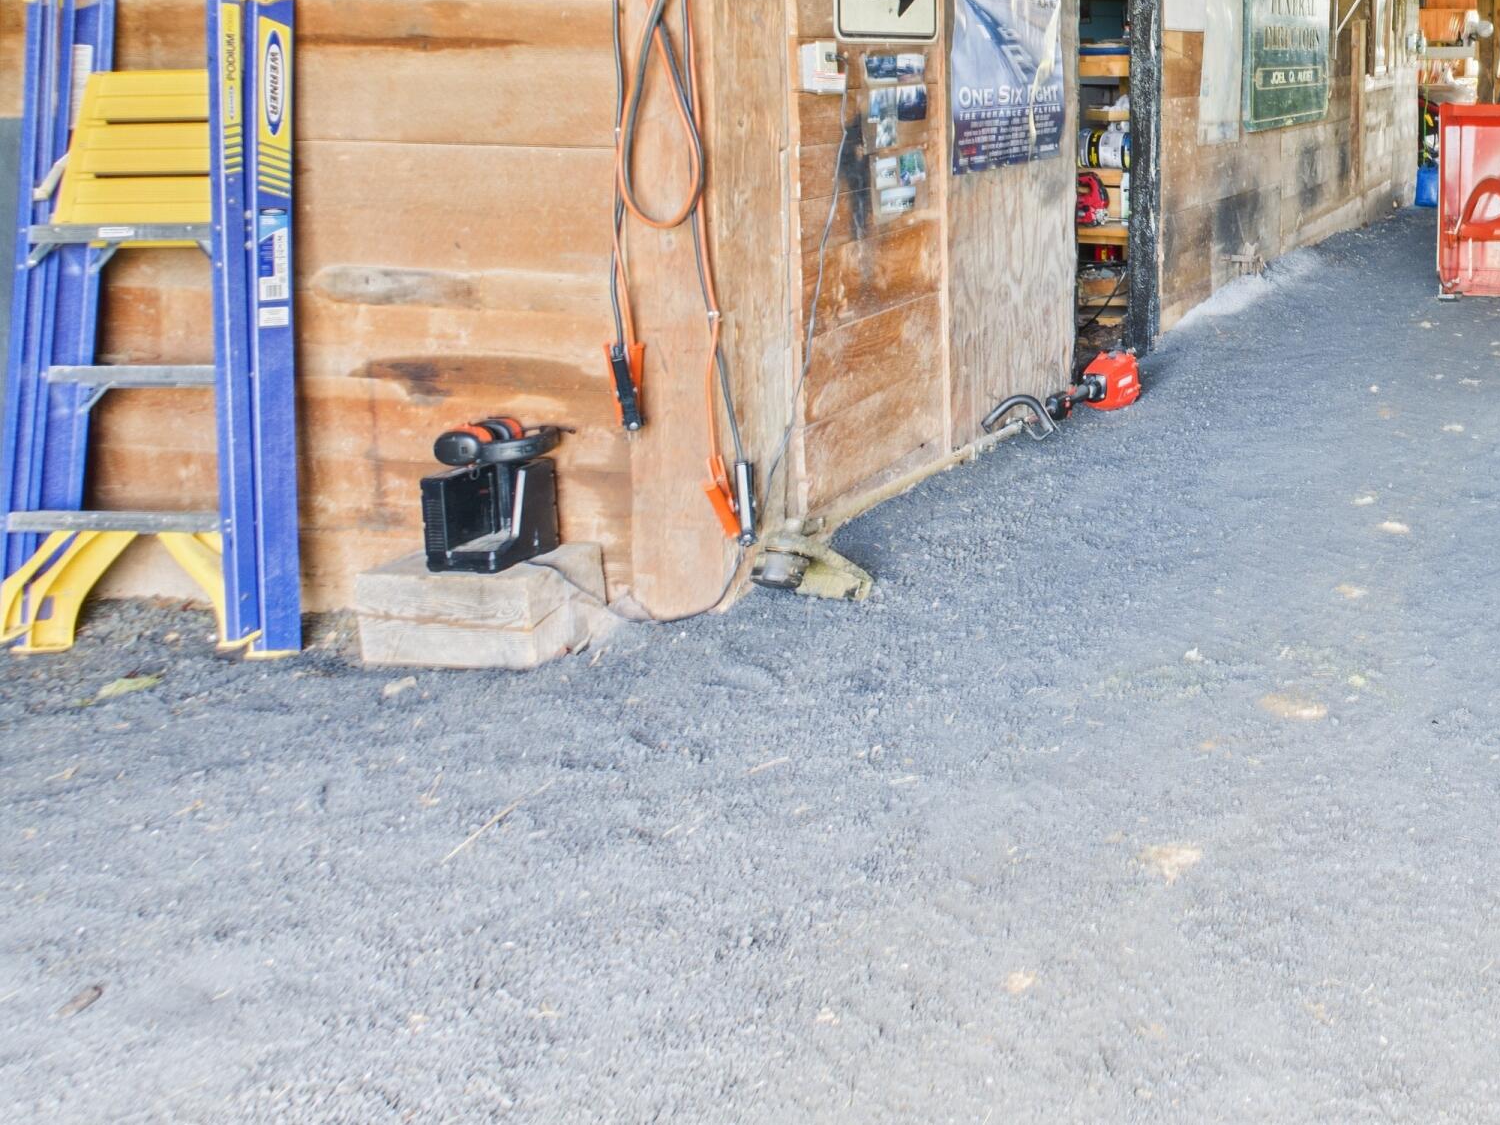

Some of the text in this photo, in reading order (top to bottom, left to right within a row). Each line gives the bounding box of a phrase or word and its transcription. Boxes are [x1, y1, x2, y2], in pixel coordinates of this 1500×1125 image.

[1263, 26, 1320, 51] DIRECTORS
[226, 33, 235, 81] PODIUM
[268, 51, 280, 117] WERNER
[1270, 71, 1287, 85] JOEL
[959, 83, 1058, 108] ONE SIX GHT
[959, 111, 977, 121] THE
[980, 107, 1022, 119] ROMANCE
